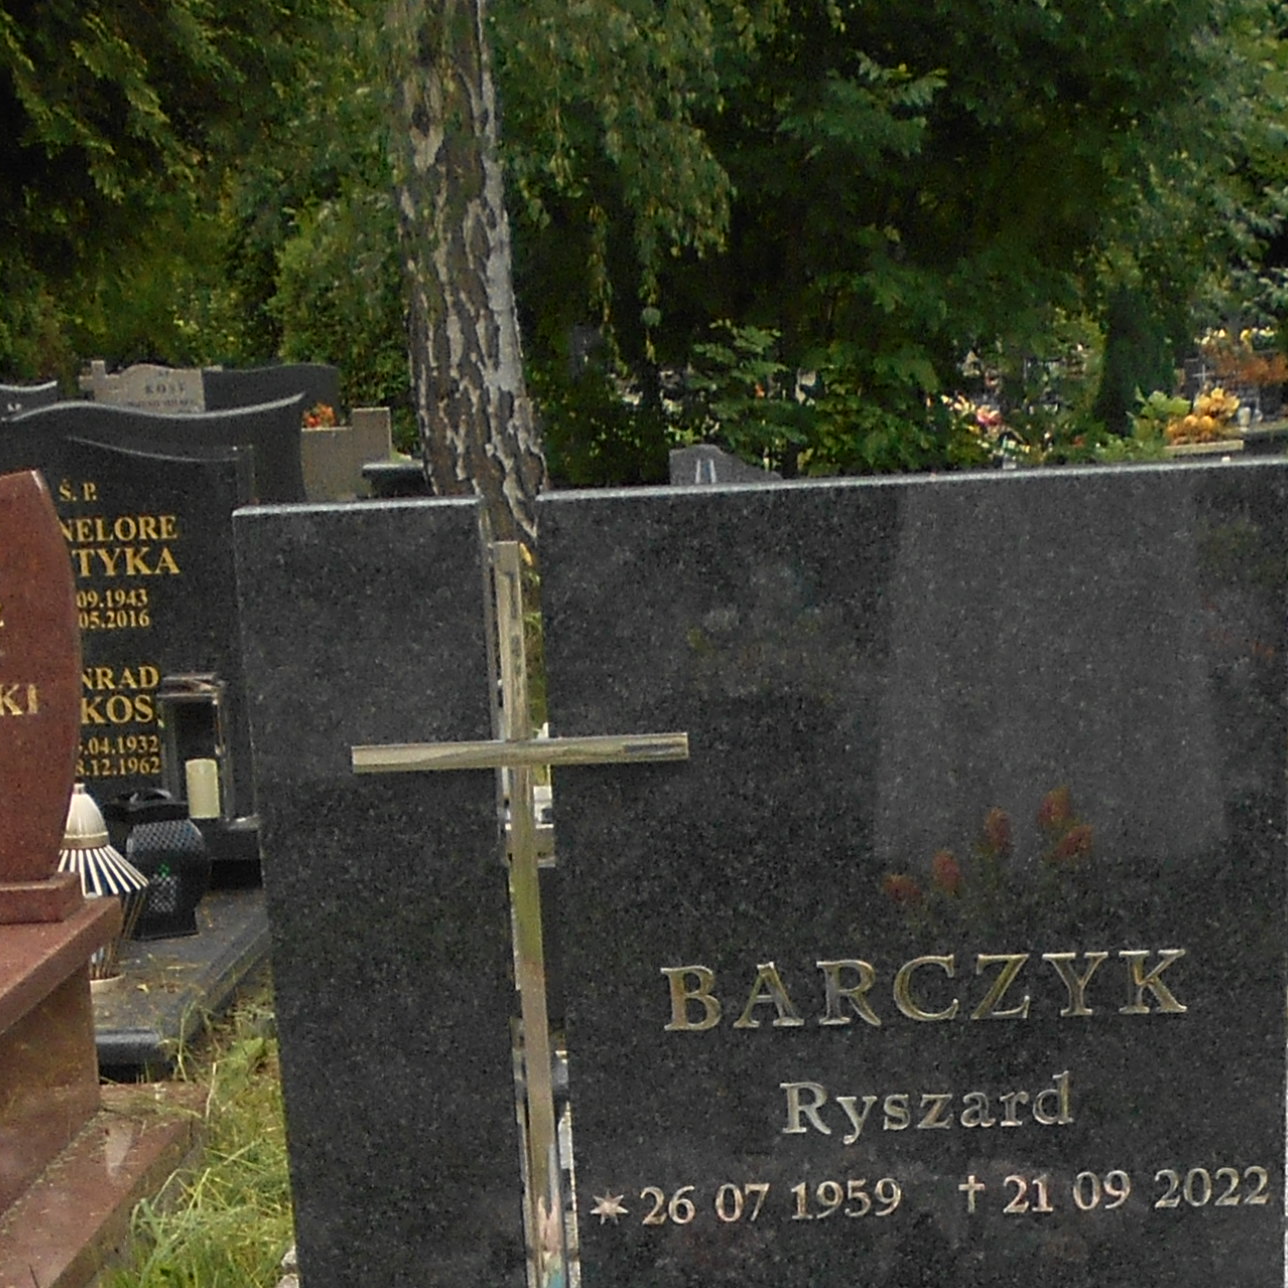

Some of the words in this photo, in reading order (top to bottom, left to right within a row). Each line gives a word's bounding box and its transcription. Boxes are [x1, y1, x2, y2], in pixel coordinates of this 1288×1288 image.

[60, 514, 179, 544] NELORE
[72, 547, 180, 577] TYKA
[76, 588, 149, 608] 09.1943
[78, 610, 150, 629] 05.2016
[81, 666, 159, 690] NRAD
[77, 737, 159, 755] .04.1932
[75, 758, 160, 777] 8.12.1962
[659, 949, 1188, 1033] BARCZYK
[781, 1071, 1074, 1144] Ryszard
[640, 1186, 696, 1226] 26
[715, 1183, 771, 1222] 07
[790, 1178, 902, 1221] 1959
[1002, 1173, 1055, 1214] 21
[1073, 1170, 1131, 1210] 09
[1154, 1166, 1271, 1209] 2022
